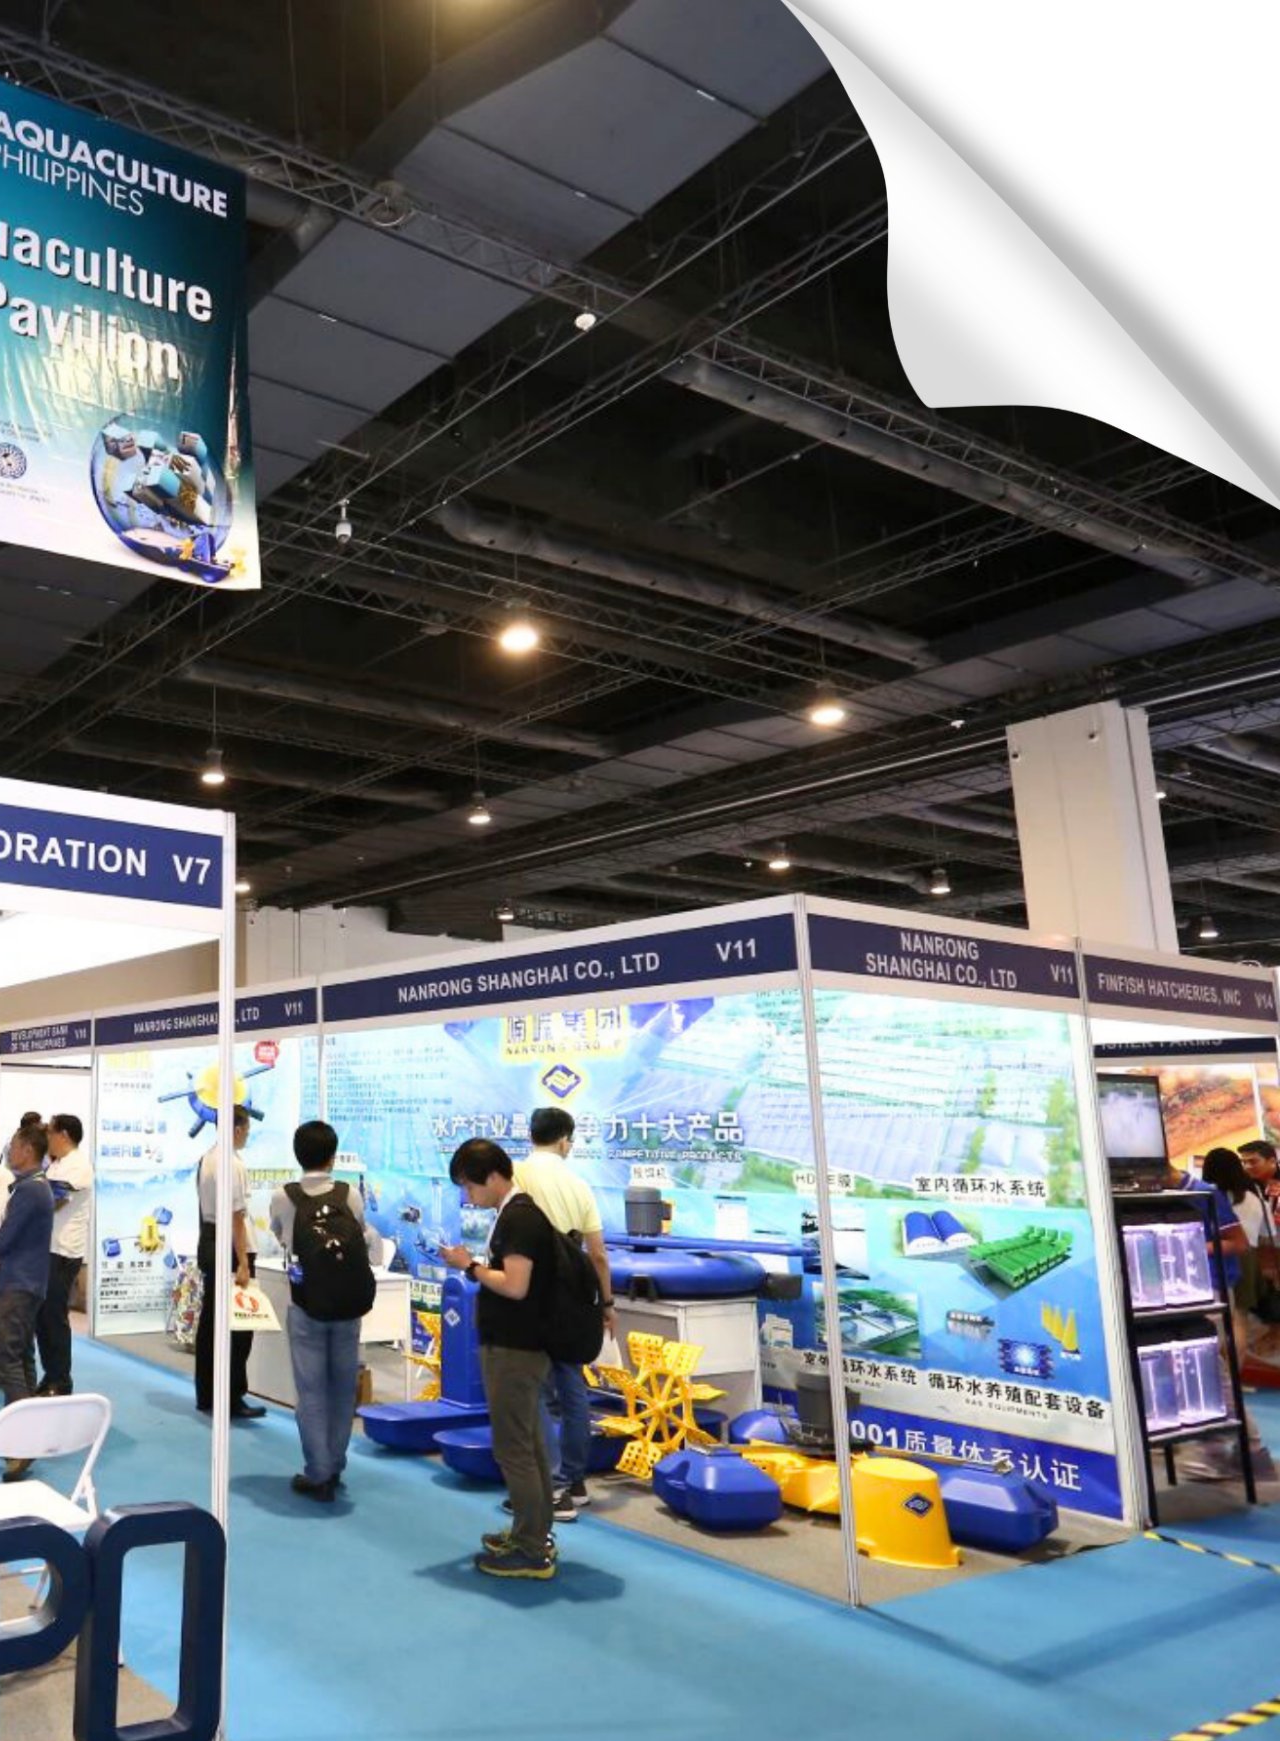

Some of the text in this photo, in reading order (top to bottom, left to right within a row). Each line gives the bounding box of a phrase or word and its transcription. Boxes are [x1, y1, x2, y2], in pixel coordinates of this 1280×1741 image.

[172, 854, 212, 886] V7
[900, 932, 979, 960] NANRONG
[398, 938, 757, 1003] NANRONG SHANGHAI CO., LTD V11
[866, 952, 1074, 989] SHANGHAI CO., LTD V11
[1097, 972, 1145, 995] FINFISH
[241, 1006, 260, 1022] LTD
[284, 1000, 304, 1017] V11
[432, 1110, 745, 1145] 水产行业最争力十大产品
[915, 1176, 1046, 1198] 室内循环水系统
[928, 1371, 1106, 1420] 循环水养殖配套设备
[848, 1419, 1083, 1492] 001质量体系认证
